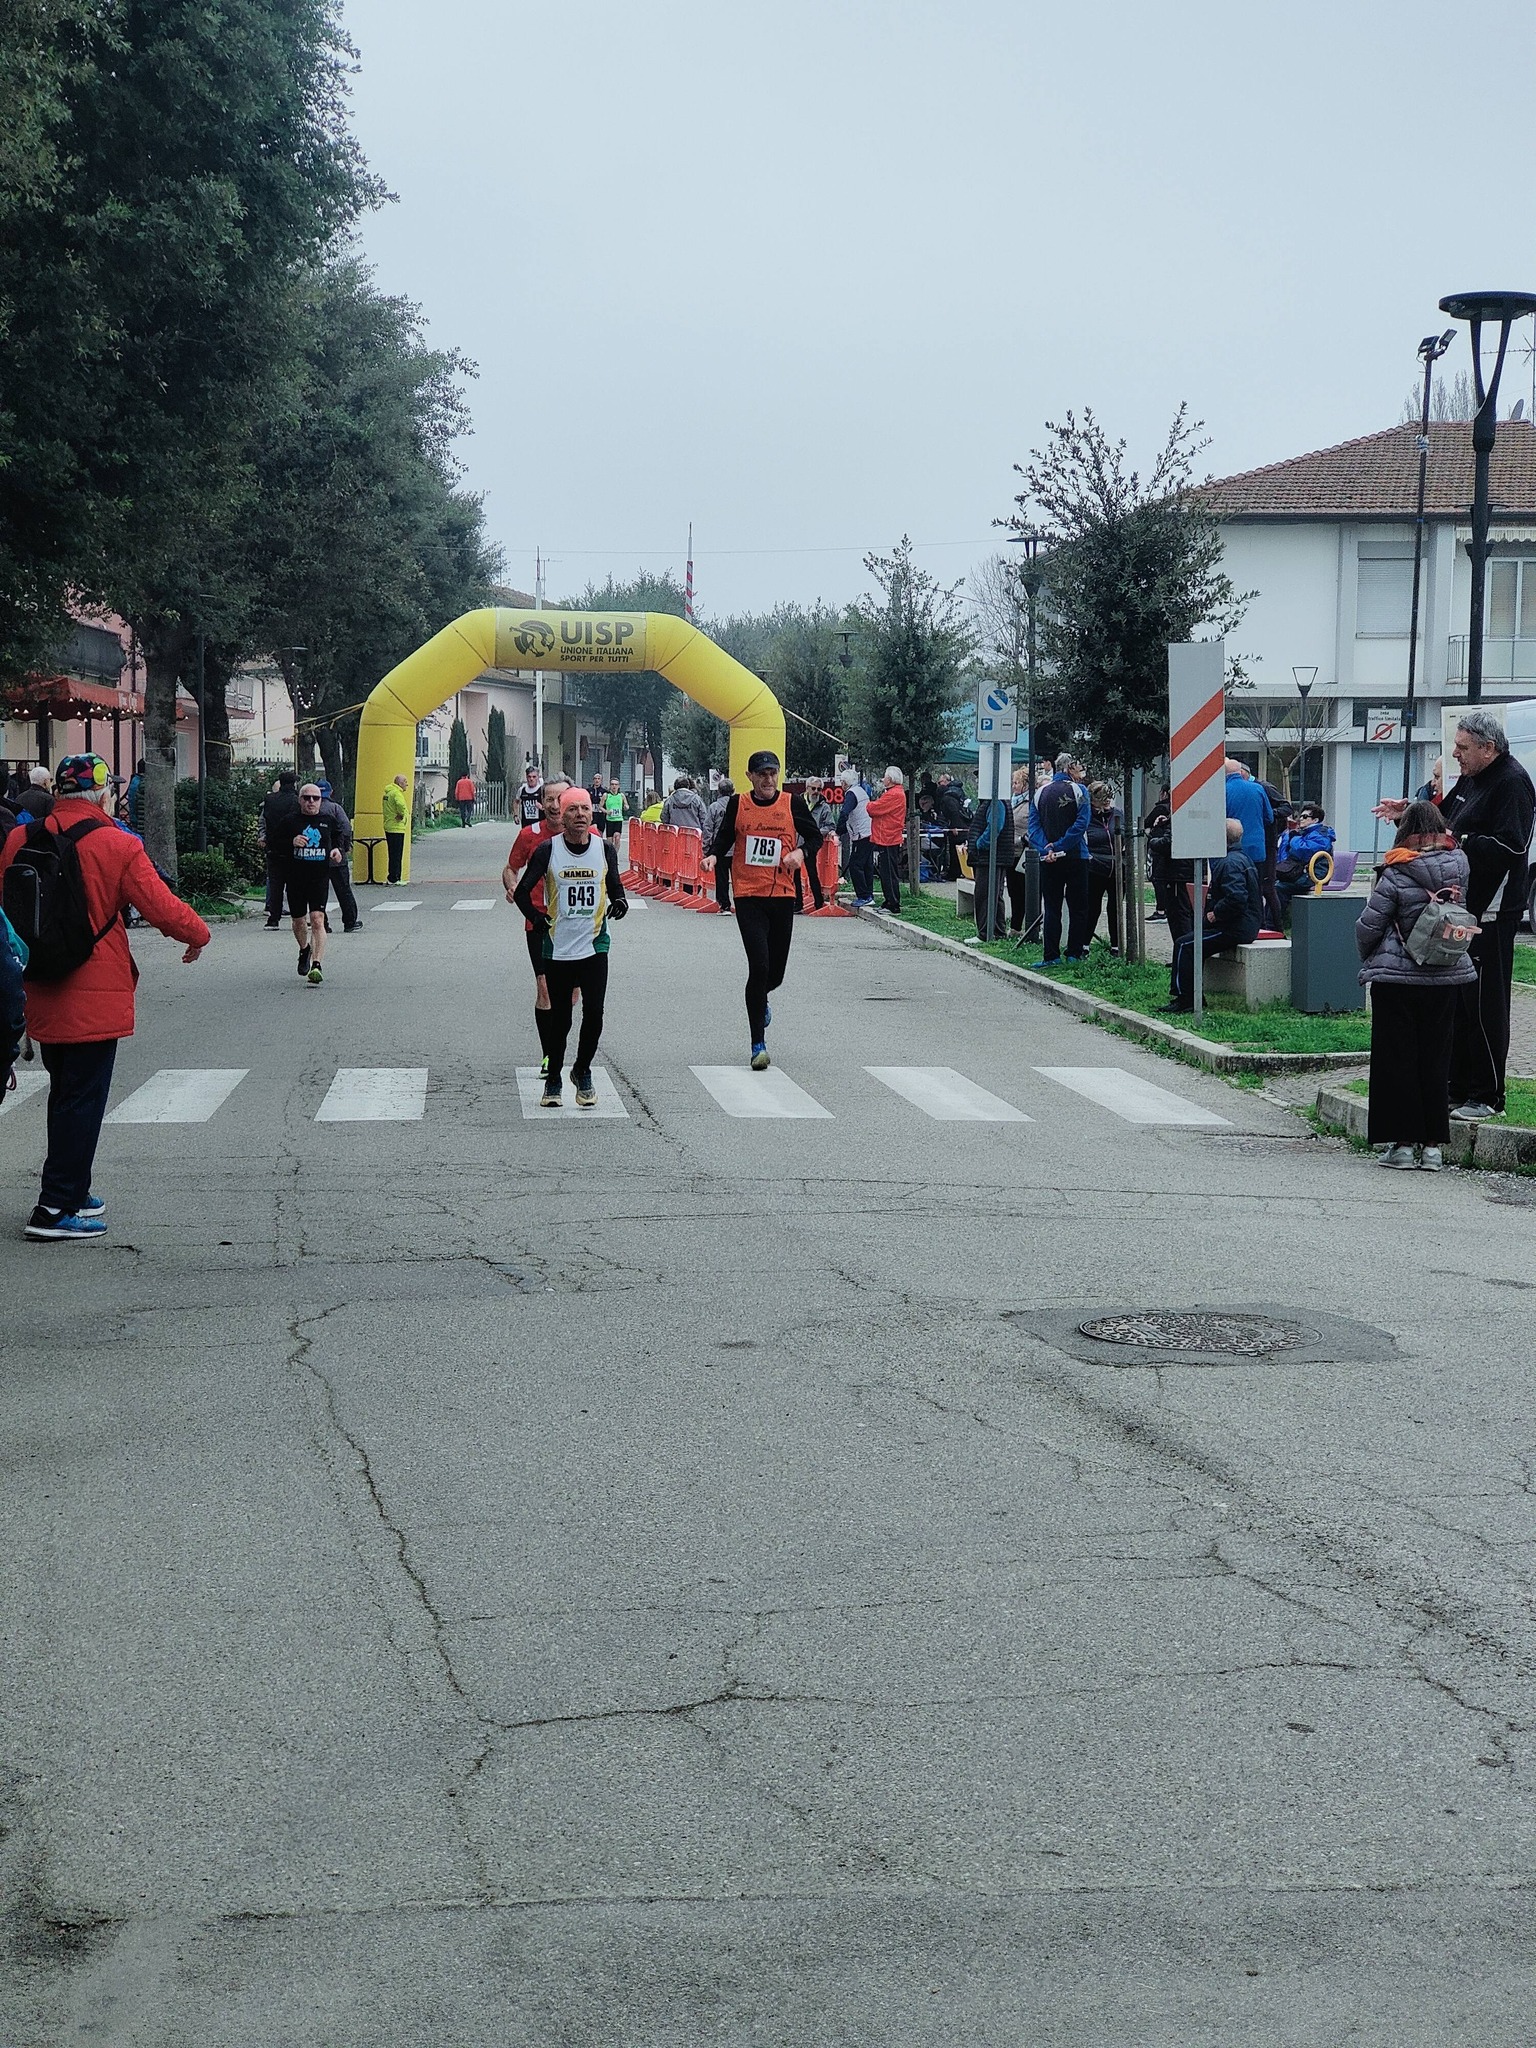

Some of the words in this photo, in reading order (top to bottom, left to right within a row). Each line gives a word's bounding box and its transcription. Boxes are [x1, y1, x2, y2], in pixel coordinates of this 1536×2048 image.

[560, 620, 634, 645] UISP
[560, 646, 593, 655] UNIONE
[596, 647, 634, 655] ITALIANA
[560, 654, 587, 662] SPORT
[589, 655, 604, 663] PER
[607, 655, 629, 663] TUTTI
[983, 719, 991, 729] P
[752, 837, 776, 857] 783
[293, 848, 326, 857] FAENZA
[563, 870, 594, 878] MAMELI
[568, 886, 595, 907] 643
